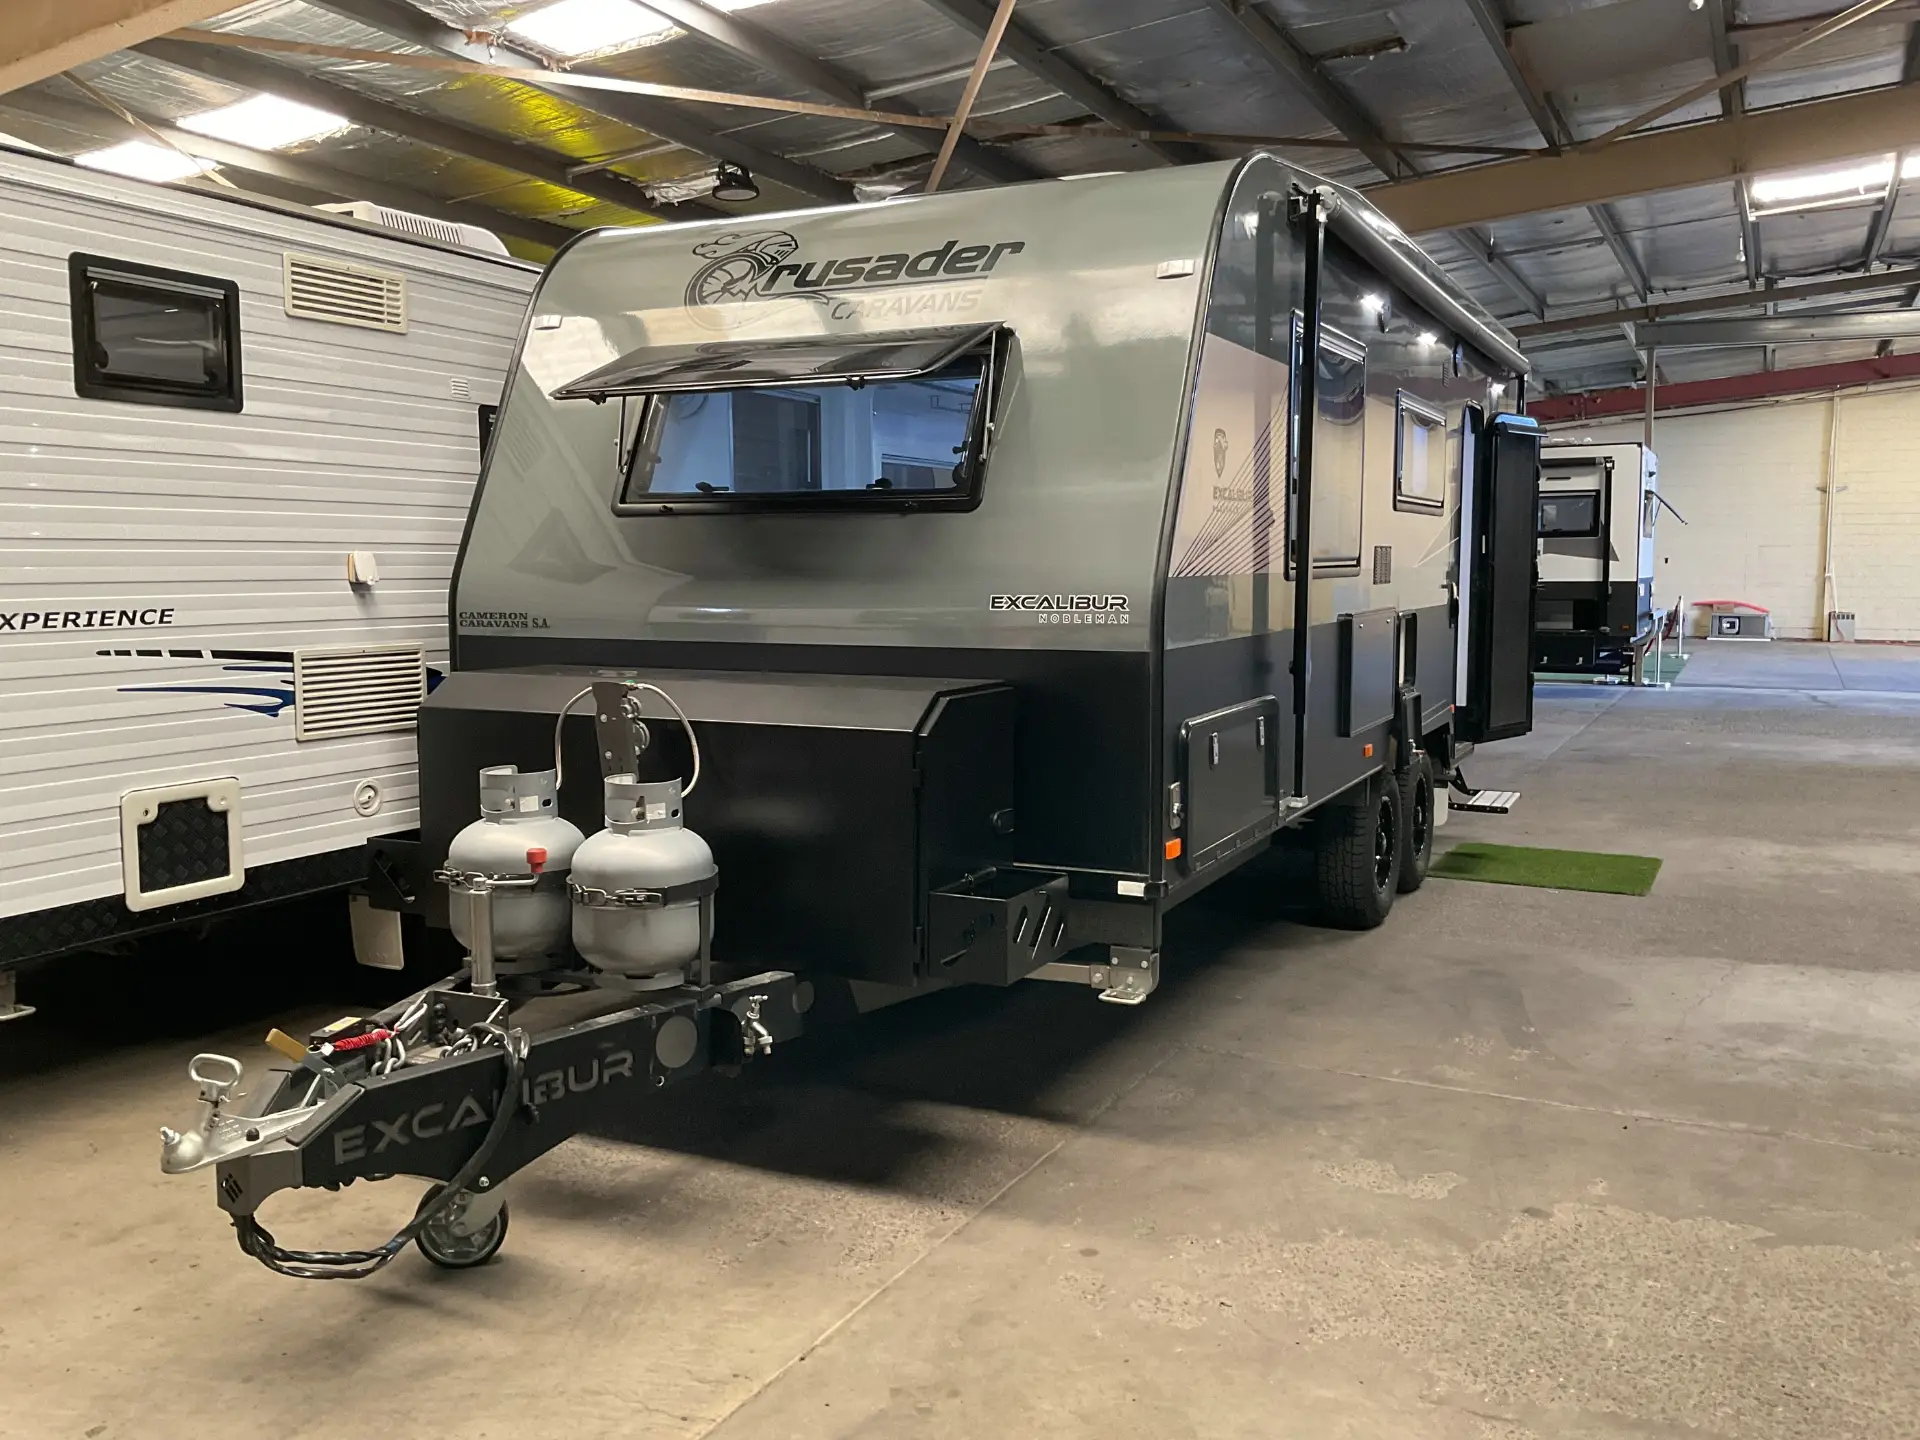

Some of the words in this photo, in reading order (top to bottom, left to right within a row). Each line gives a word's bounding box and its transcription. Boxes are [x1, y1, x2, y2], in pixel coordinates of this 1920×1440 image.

[831, 290, 982, 320] CARAVANS
[989, 595, 1130, 611] EXCALIBUR
[0, 608, 175, 631] XPERIENCE
[459, 612, 528, 620] CAMERON
[1038, 614, 1130, 624] NOBLEMAN
[459, 620, 528, 628] CARAVANS
[532, 618, 550, 628] S.A.
